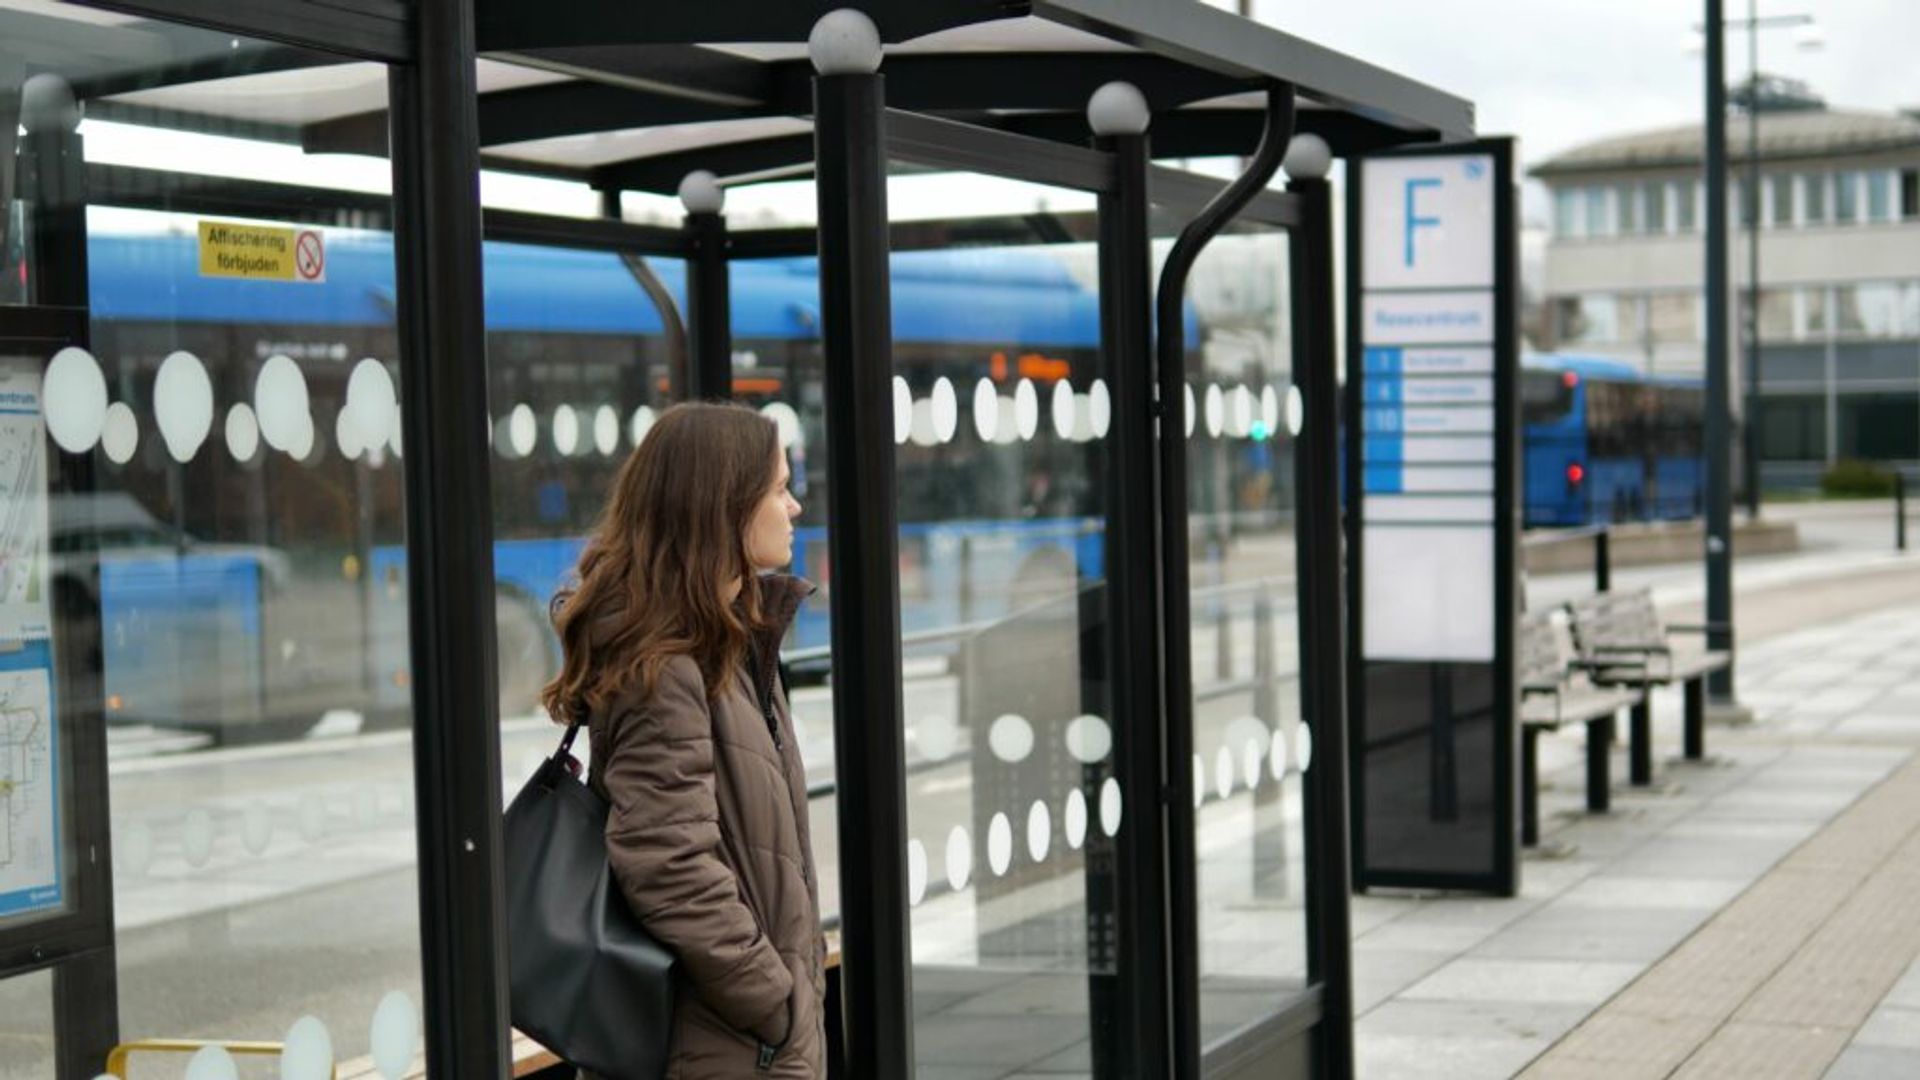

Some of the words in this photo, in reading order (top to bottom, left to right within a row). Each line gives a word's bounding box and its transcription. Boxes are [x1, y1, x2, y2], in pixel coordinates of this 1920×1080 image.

[1404, 178, 1443, 268] F
[208, 227, 286, 253] Affischering
[217, 253, 280, 276] förbjuden
